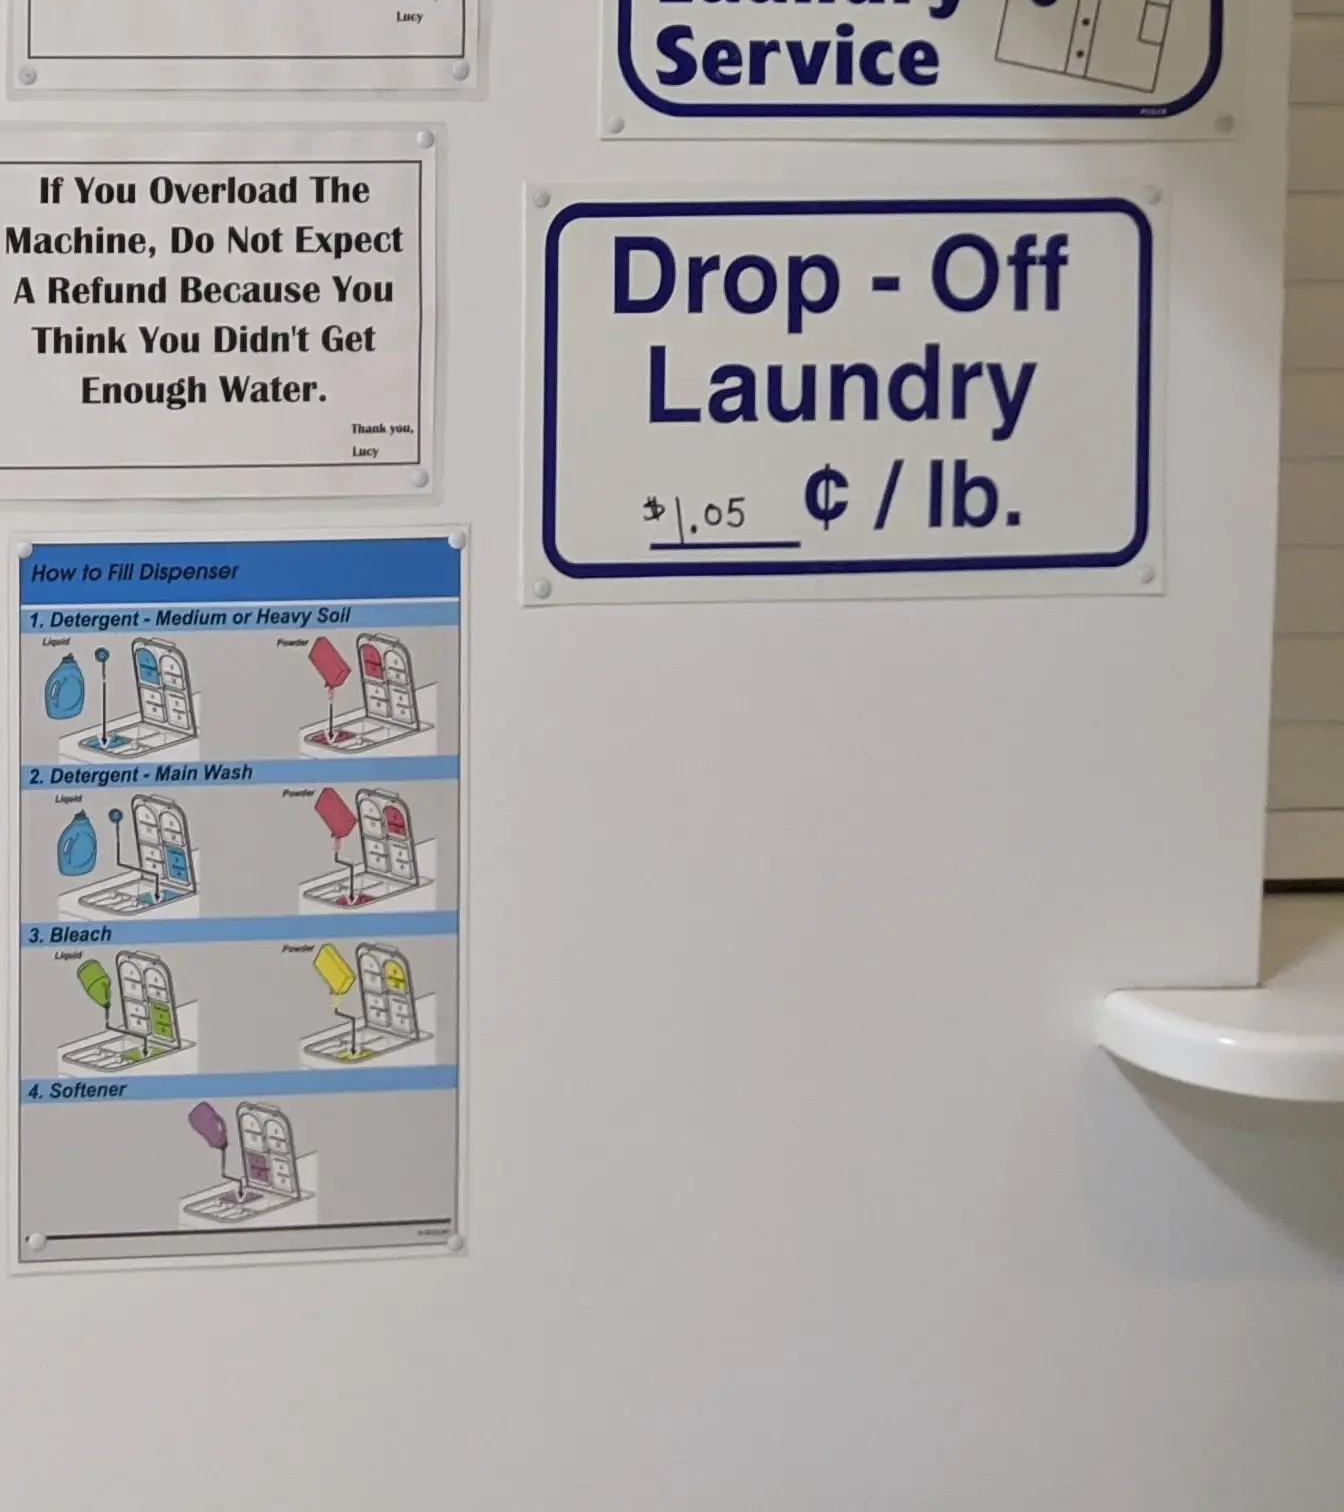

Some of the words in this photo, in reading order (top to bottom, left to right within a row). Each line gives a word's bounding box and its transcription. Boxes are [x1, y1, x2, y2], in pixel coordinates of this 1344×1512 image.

[656, 23, 939, 86] Service
[40, 177, 64, 204] If
[74, 177, 135, 204] You
[150, 176, 297, 204] Overload
[309, 176, 369, 203] The
[614, 236, 840, 334] Drop
[872, 276, 900, 291] -
[932, 233, 1068, 312] Off
[82, 376, 206, 410] Enough
[219, 376, 326, 403] Water.
[649, 343, 1037, 441] Laundry
[643, 496, 746, 543] $1.05
[805, 463, 848, 531] ¢
[873, 459, 904, 530] /
[928, 459, 1020, 528] lb.
[28, 1084, 43, 1099] 4.
[49, 1082, 128, 1099] Softener
